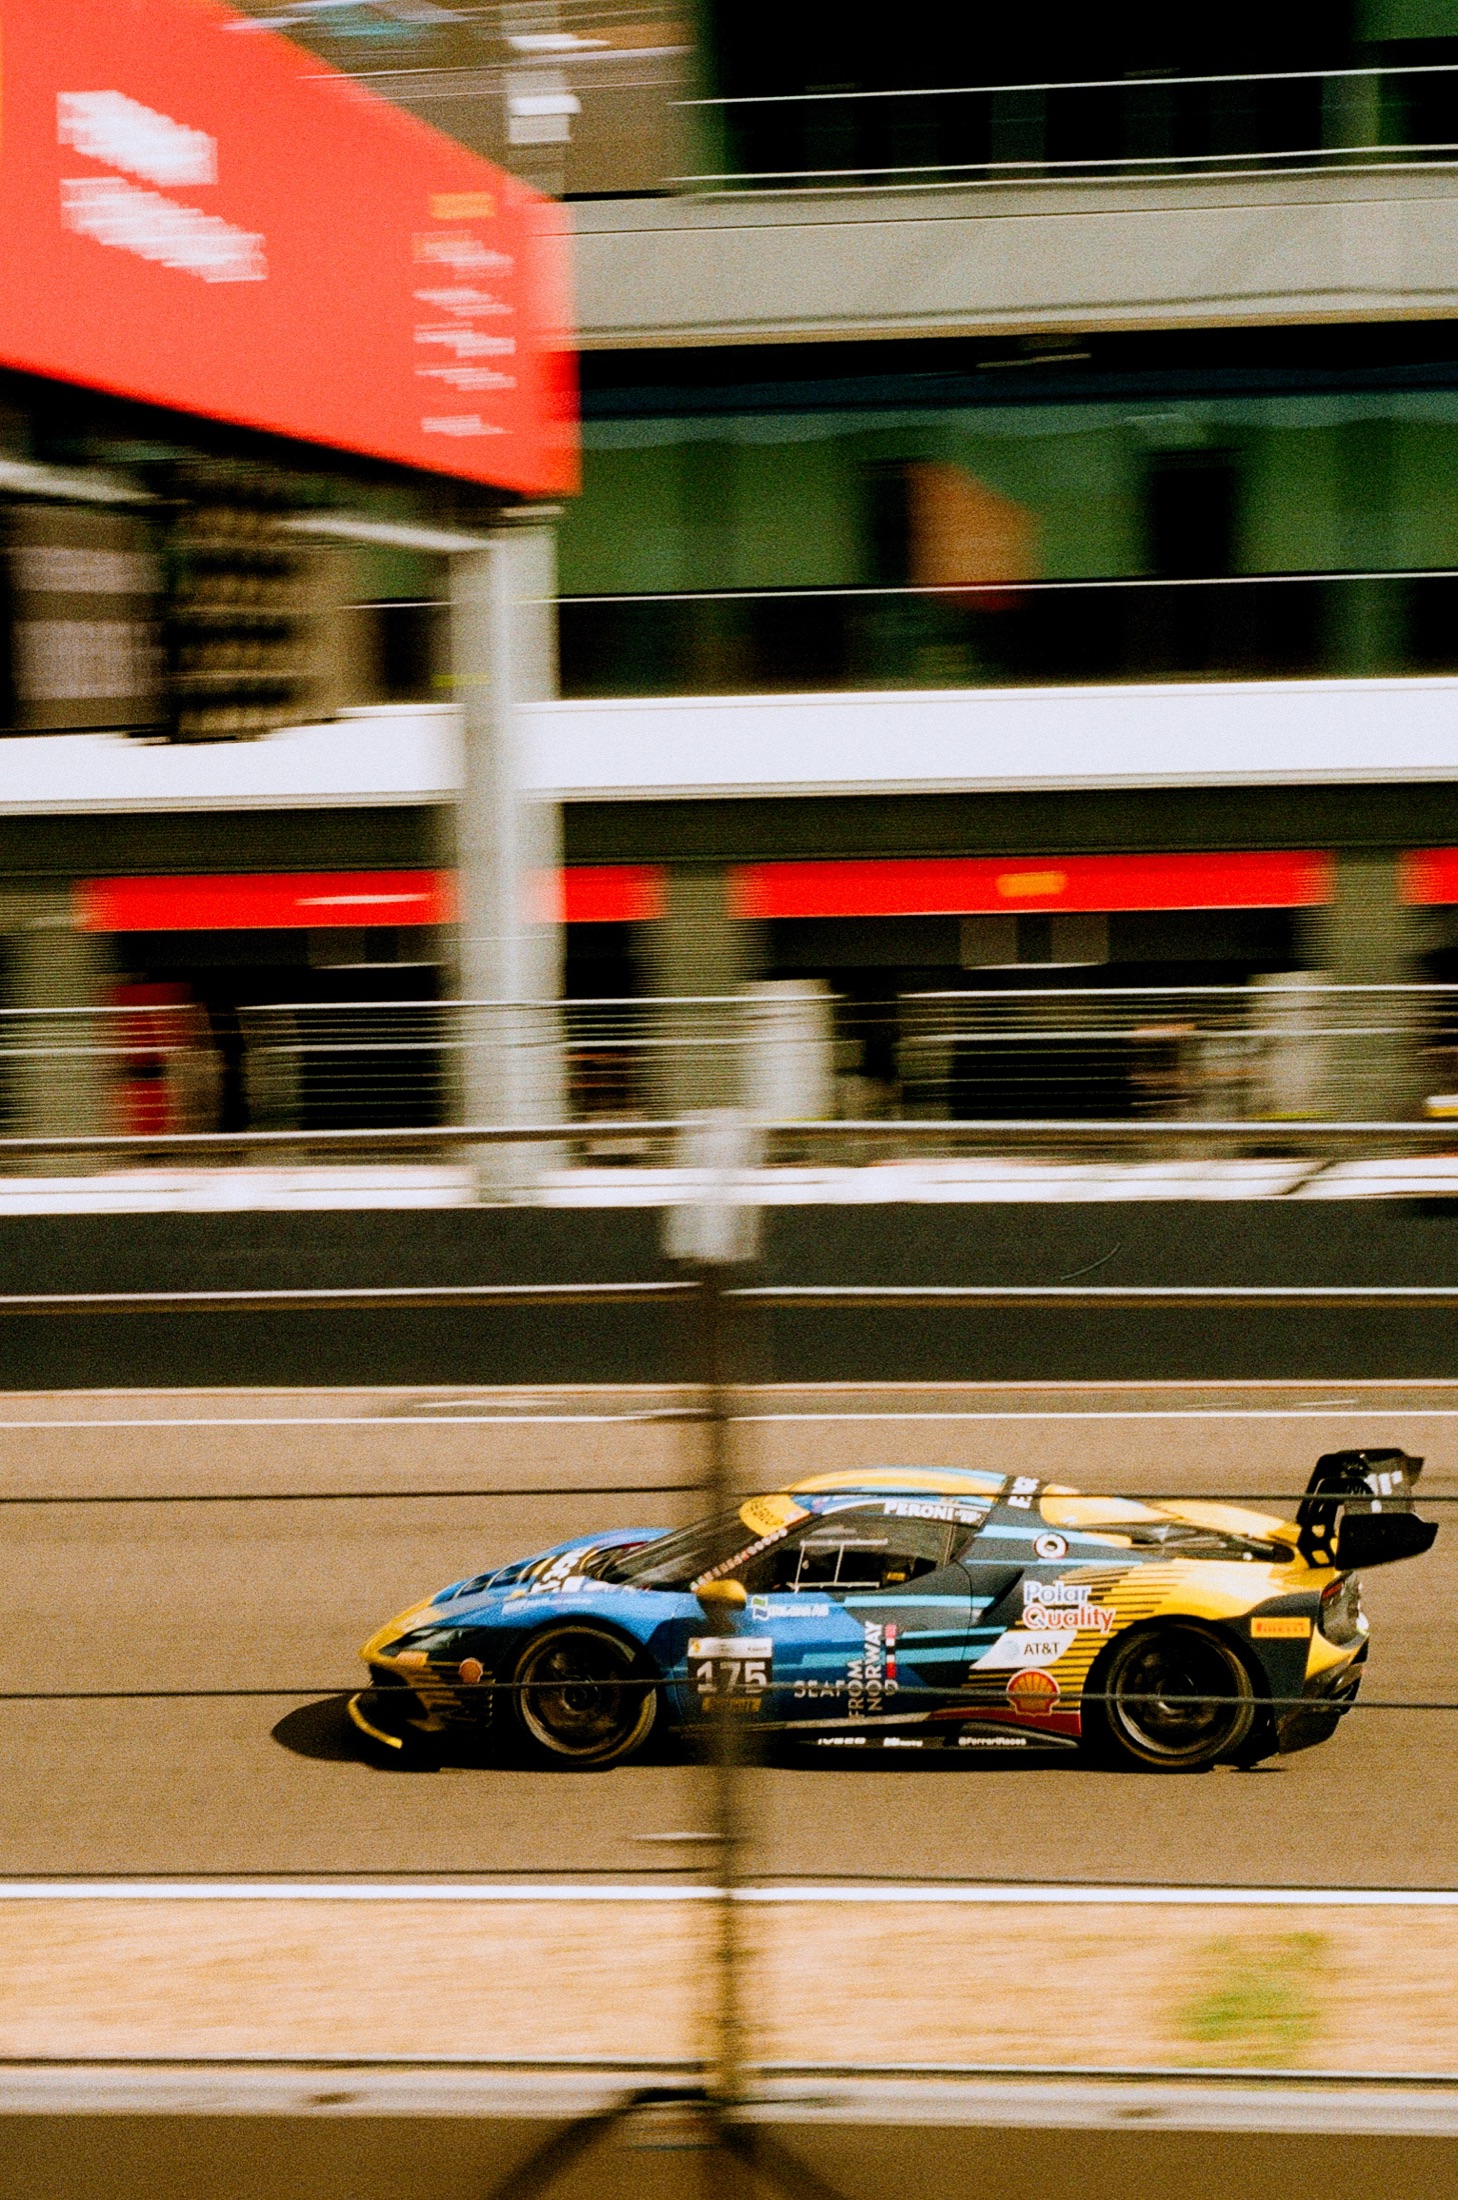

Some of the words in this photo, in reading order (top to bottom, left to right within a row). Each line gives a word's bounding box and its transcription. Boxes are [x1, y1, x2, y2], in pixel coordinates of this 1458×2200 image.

[883, 1502, 954, 1521] PERONI
[1025, 1582, 1090, 1603] Polar
[1024, 1605, 1114, 1631] Quality
[1024, 1641, 1060, 1655] AT&T
[696, 1661, 768, 1694] 175
[865, 1620, 883, 1712] NORWAY
[848, 1659, 866, 1719] FROM
